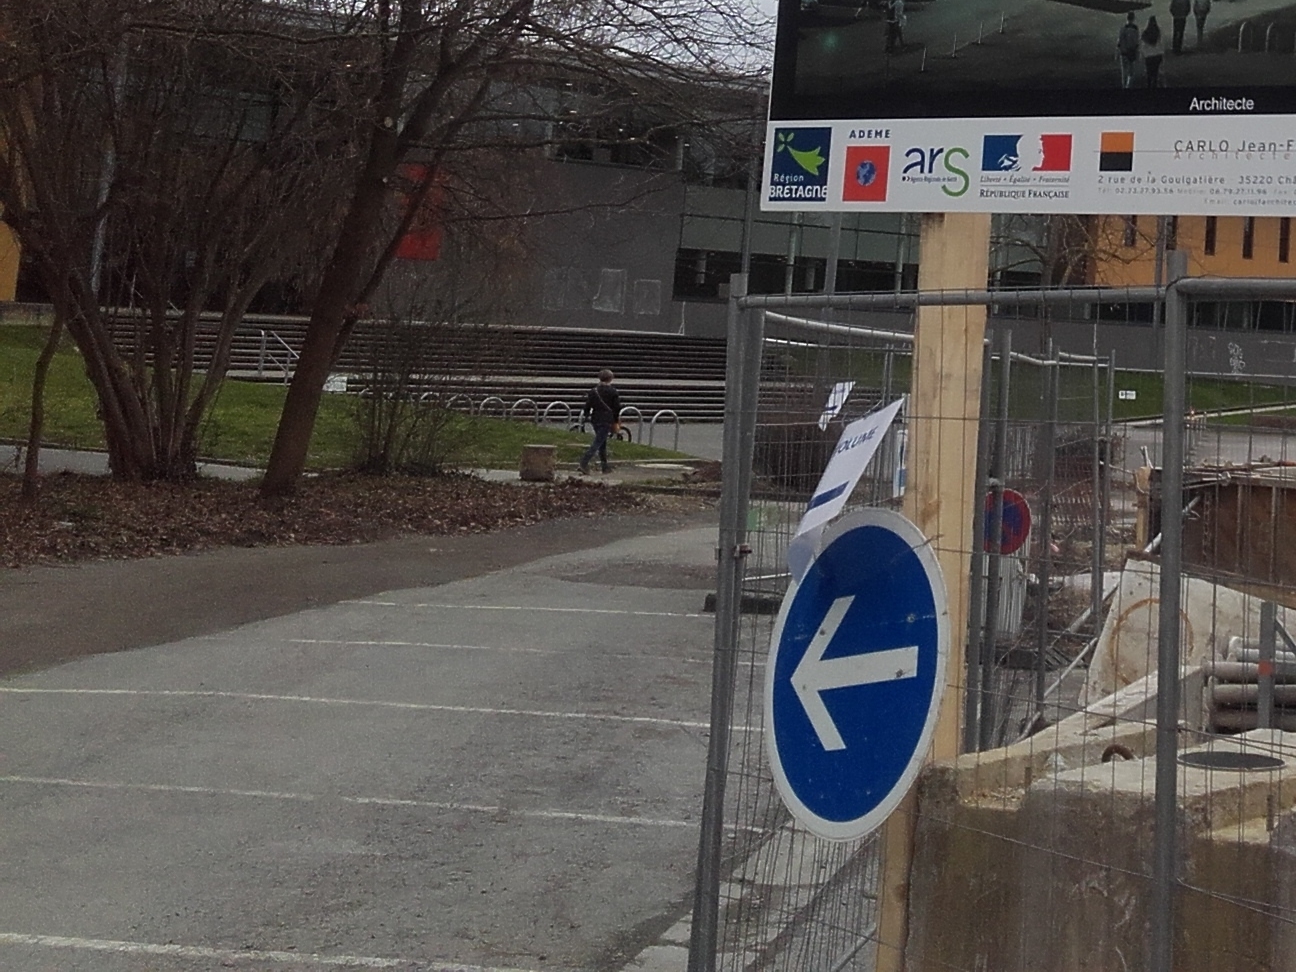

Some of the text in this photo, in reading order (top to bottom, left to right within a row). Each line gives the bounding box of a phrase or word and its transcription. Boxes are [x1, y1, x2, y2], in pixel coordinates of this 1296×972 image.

[1190, 97, 1254, 111] Architecte
[849, 129, 891, 139] ADEME
[1174, 140, 1229, 153] CARLO
[903, 147, 970, 197] ars
[773, 173, 804, 185] Région
[769, 185, 828, 198] BRETAGNE
[979, 187, 1069, 199] RÉPUBLIQUE FRANÇAISE
